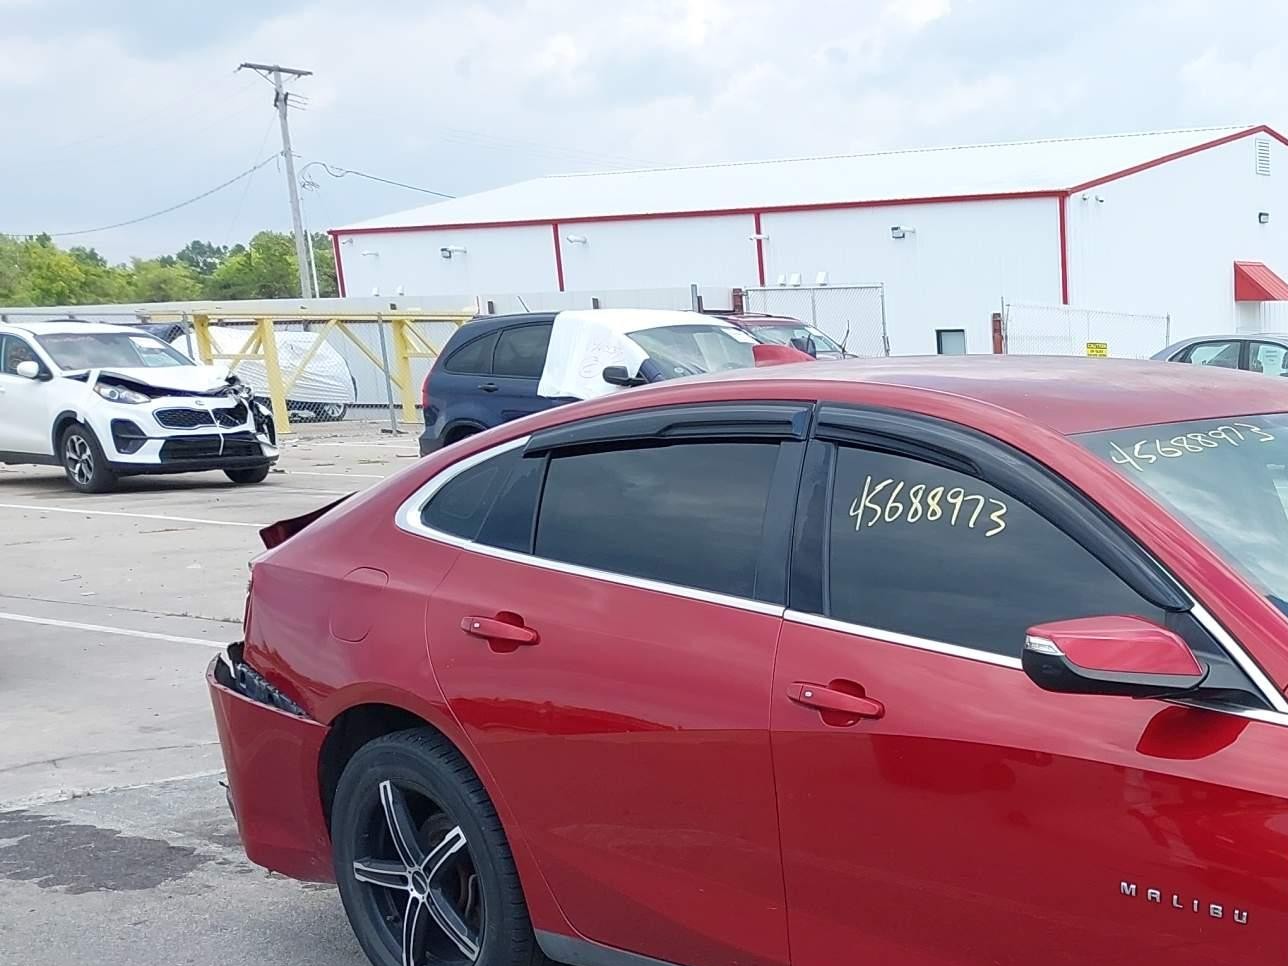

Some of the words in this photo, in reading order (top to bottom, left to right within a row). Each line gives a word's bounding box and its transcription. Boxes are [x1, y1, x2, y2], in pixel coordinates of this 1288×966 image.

[1110, 423, 1275, 472] 45688973
[849, 475, 1007, 537] 45688973
[1120, 881, 1248, 924] MALIBU
